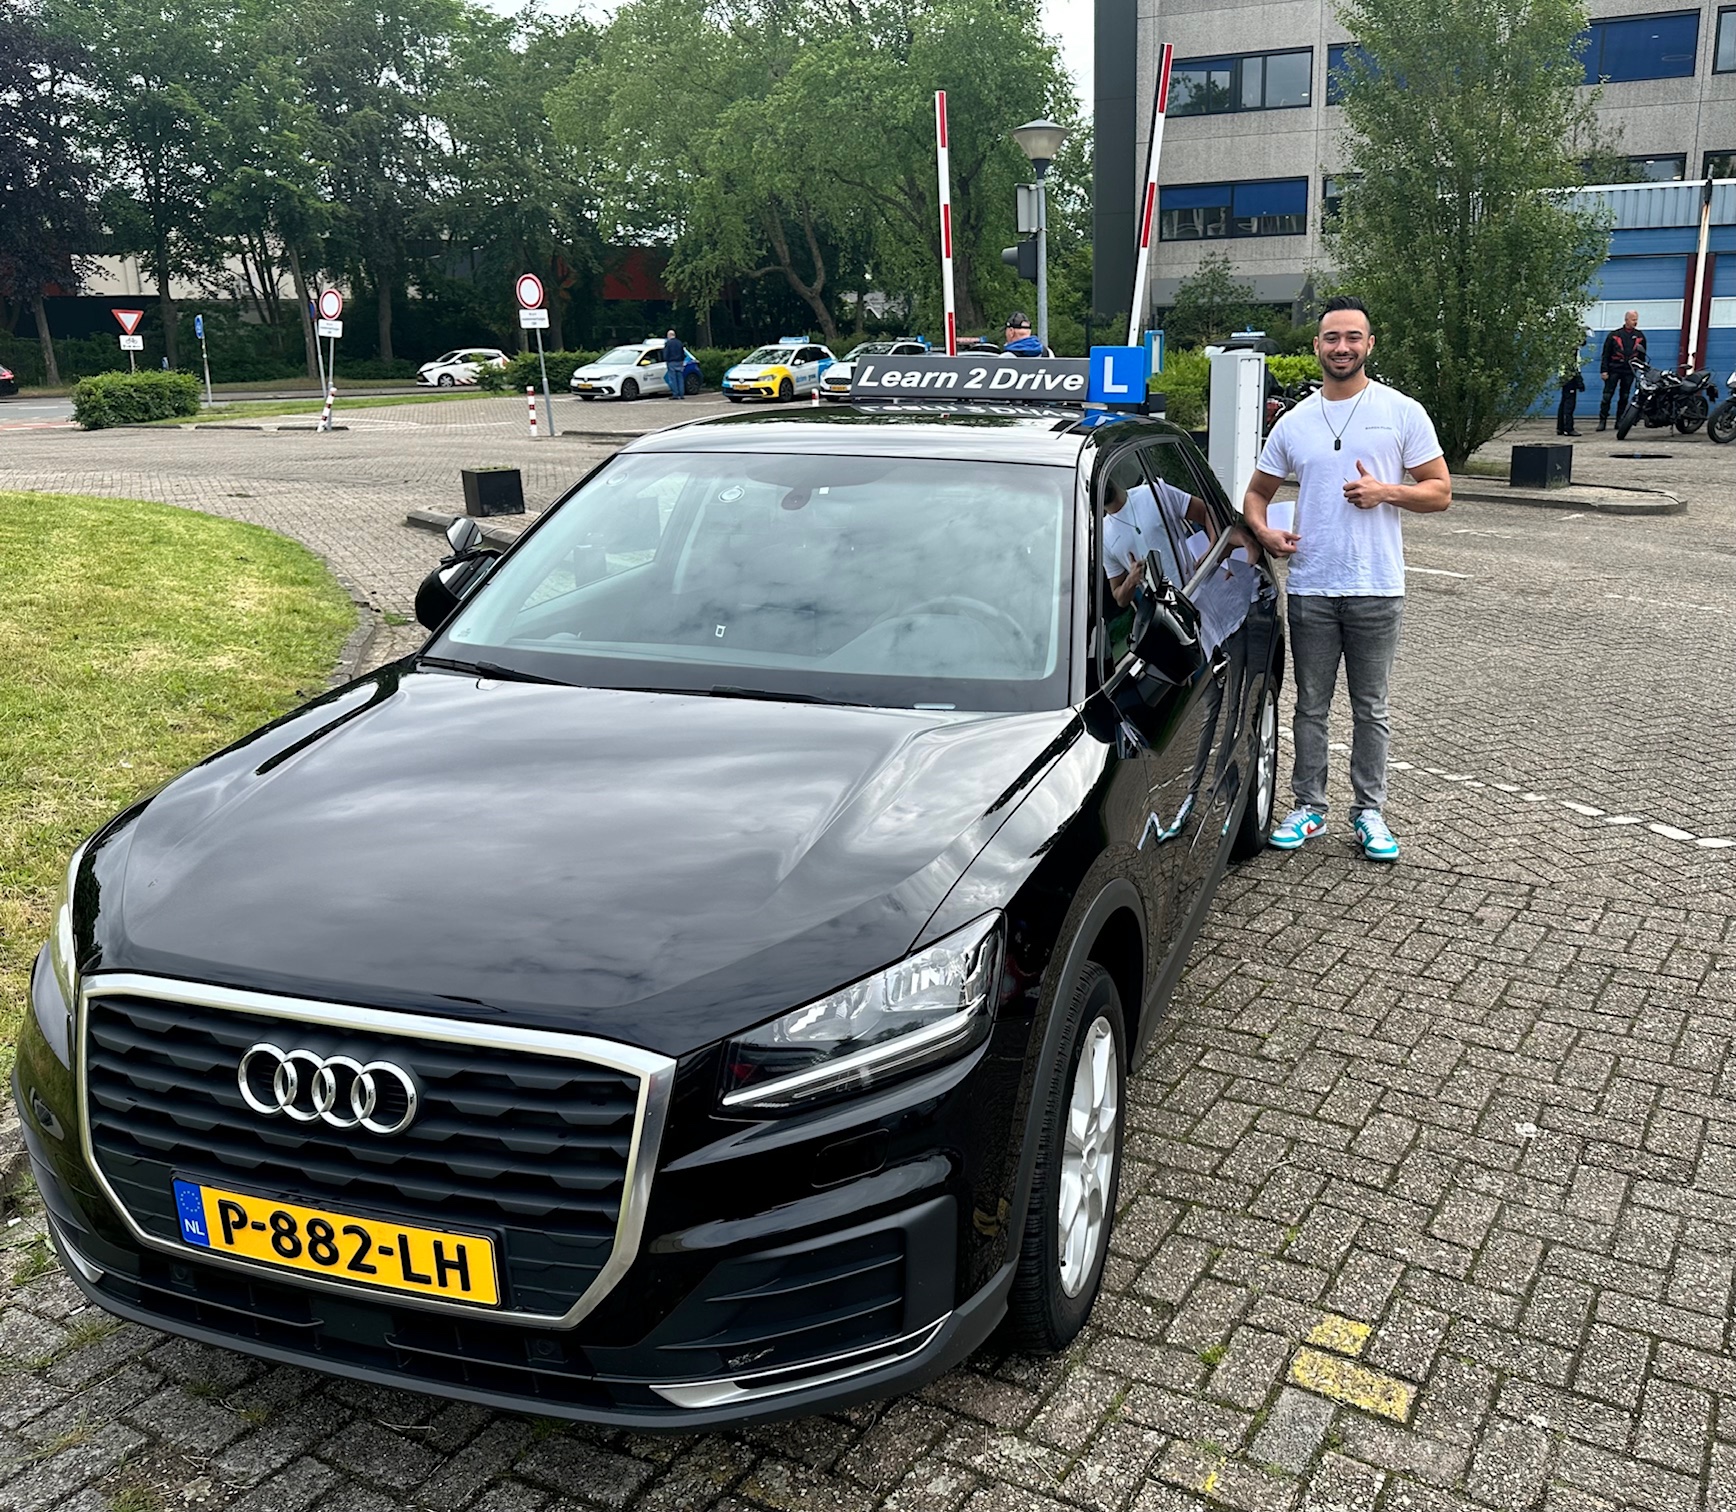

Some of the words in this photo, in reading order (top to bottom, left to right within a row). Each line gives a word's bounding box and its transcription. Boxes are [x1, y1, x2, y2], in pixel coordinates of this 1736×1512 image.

[857, 365, 958, 389] Learn
[964, 367, 988, 389] 2
[989, 368, 1085, 391] Drive
[1103, 356, 1128, 393] L
[184, 1218, 206, 1237] NL
[217, 1199, 471, 1292] P-882-LH
